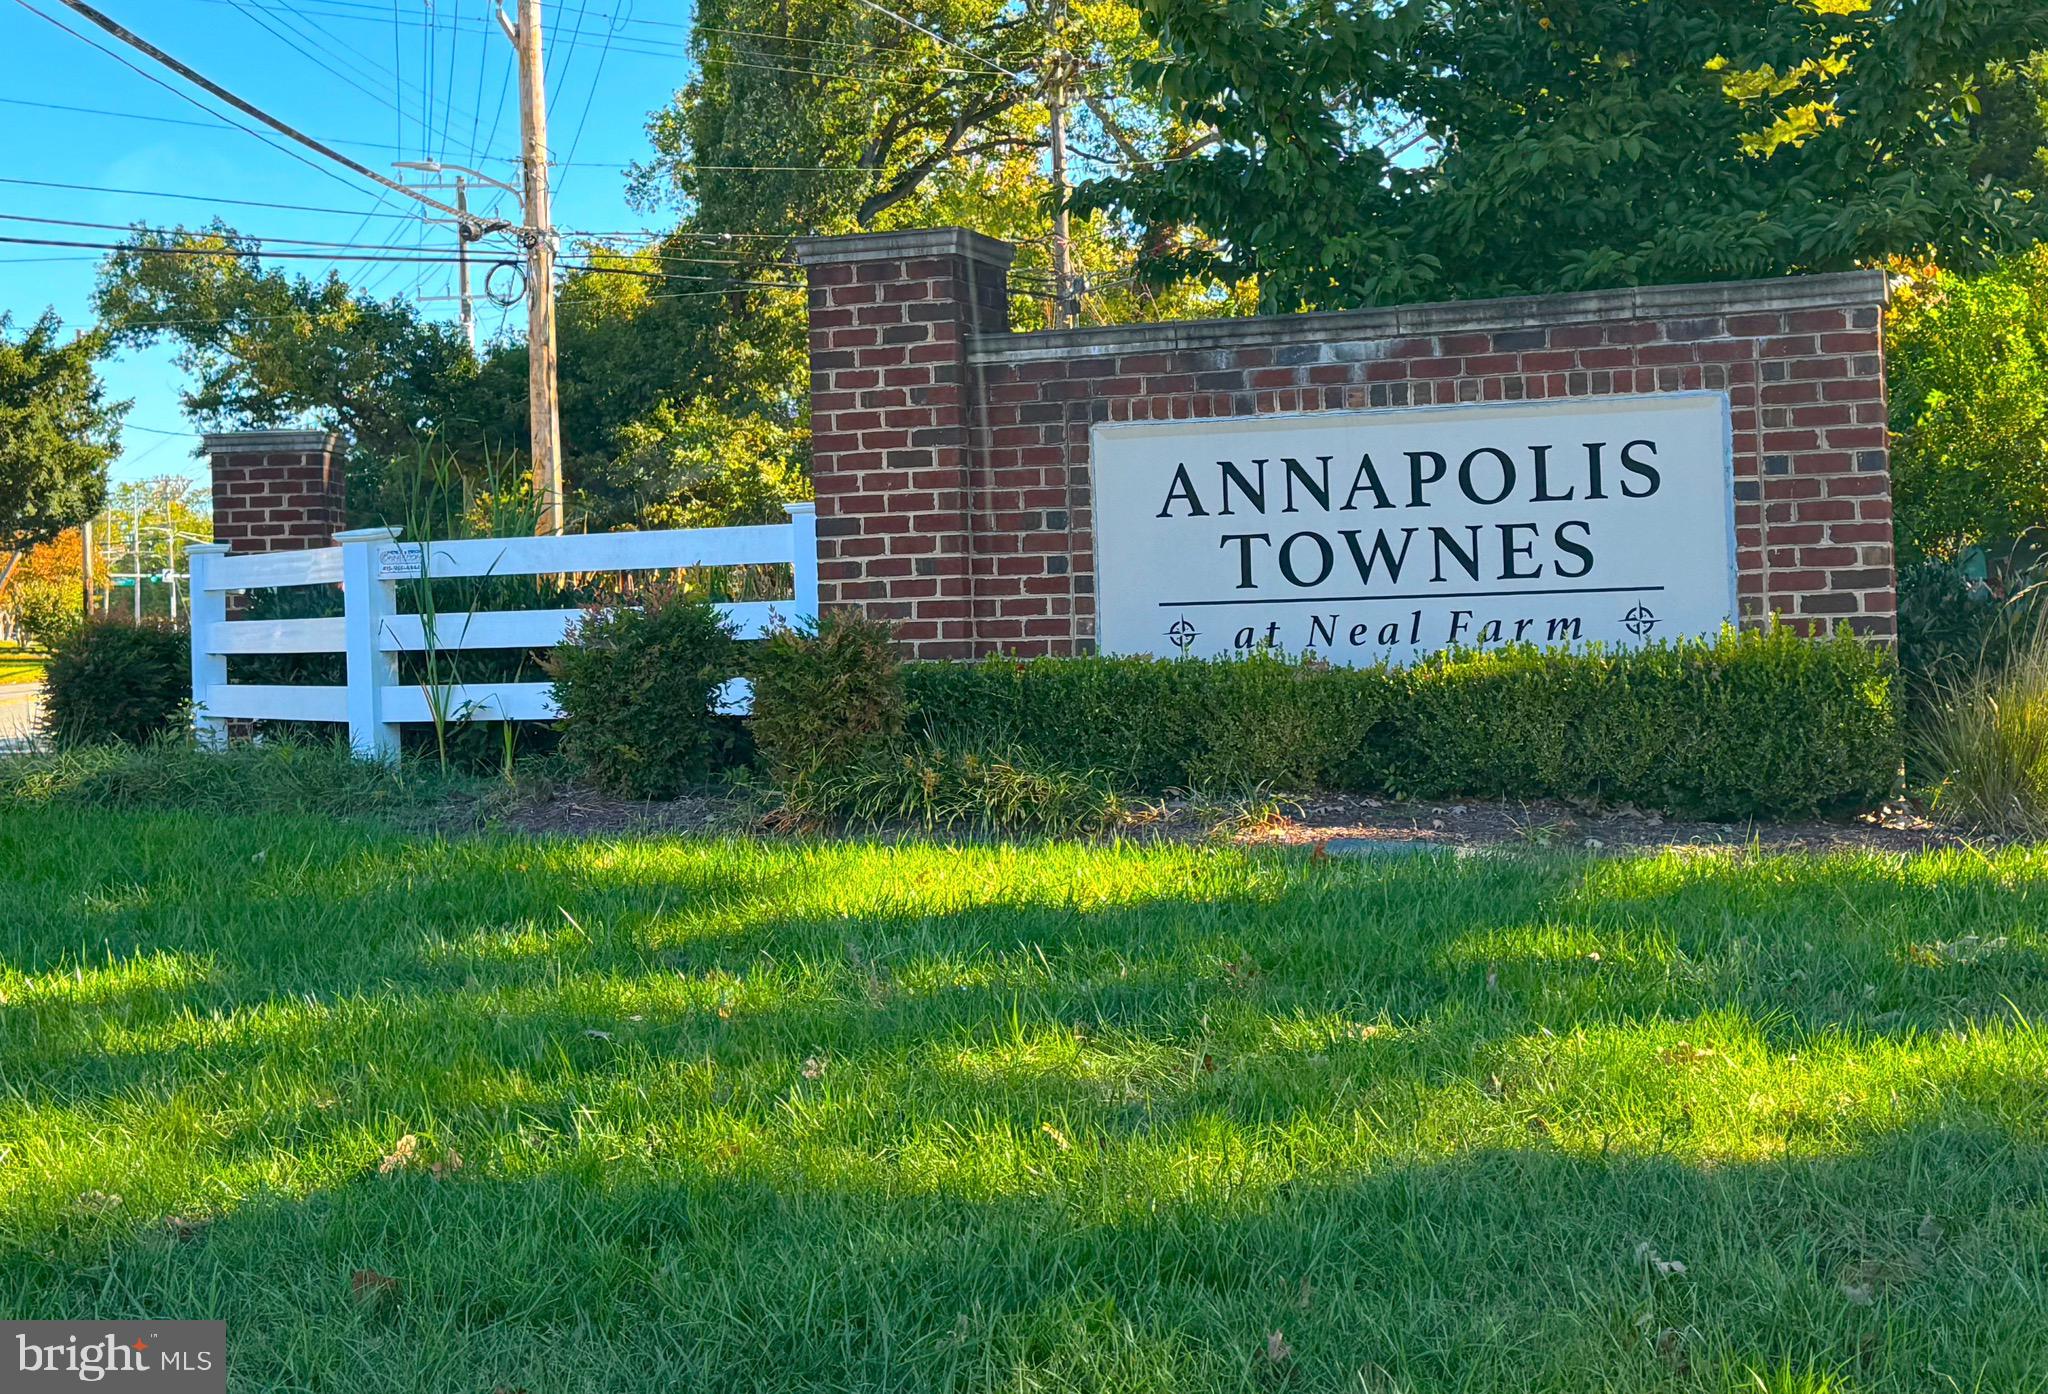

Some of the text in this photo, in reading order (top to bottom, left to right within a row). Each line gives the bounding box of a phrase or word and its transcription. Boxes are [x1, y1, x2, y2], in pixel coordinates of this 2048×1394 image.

[1155, 439, 1662, 519] ANNAPOLIS
[1219, 520, 1596, 590] TOWNES
[1233, 609, 1584, 649] at Neal Farm
